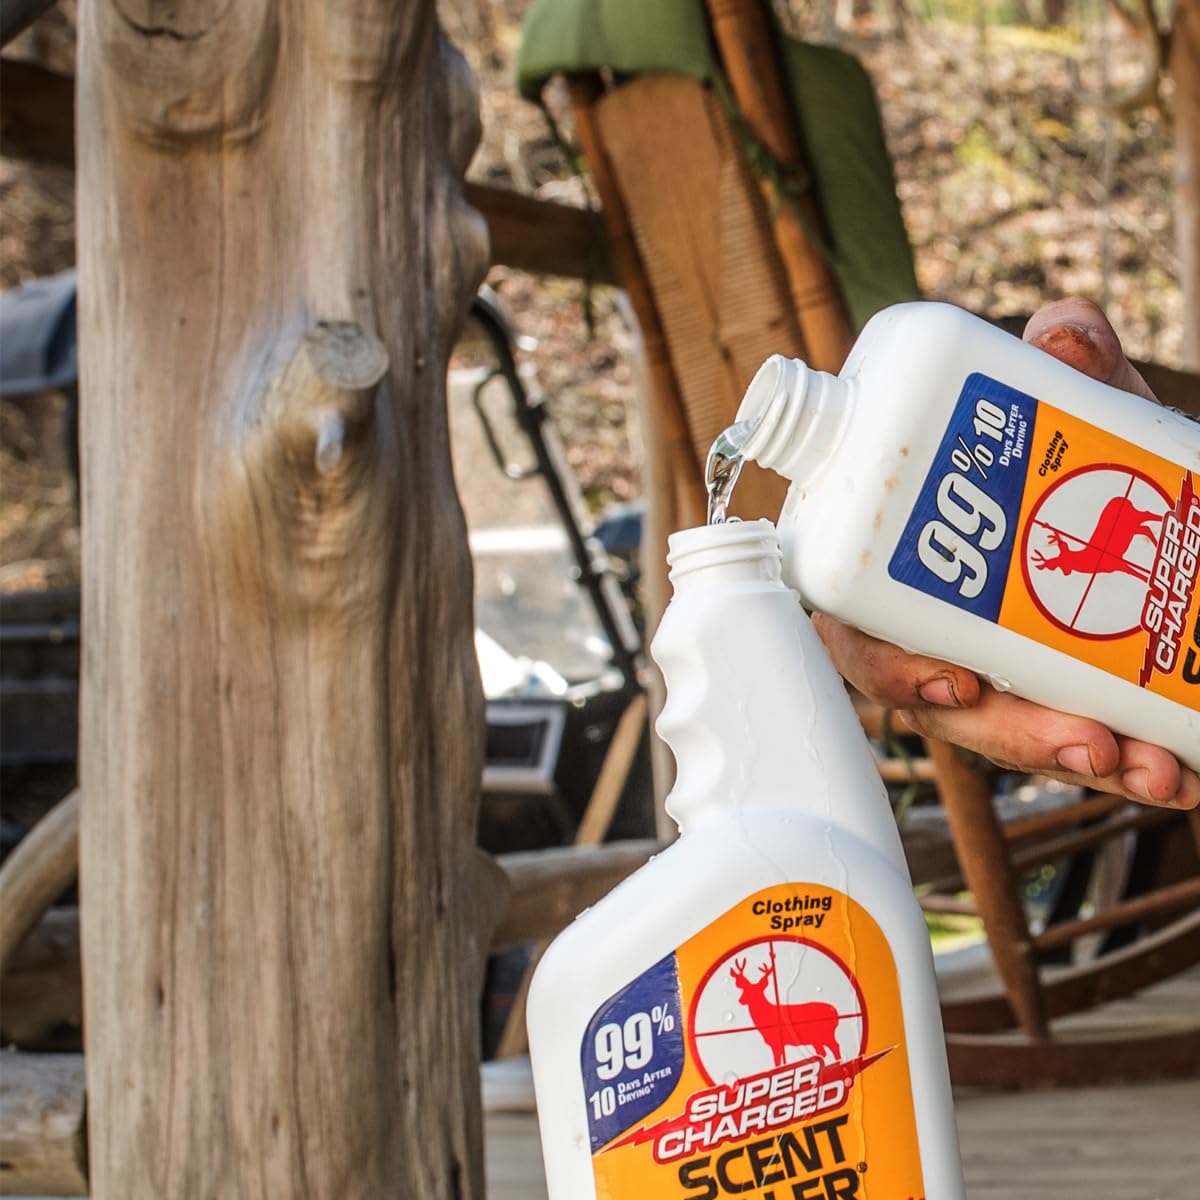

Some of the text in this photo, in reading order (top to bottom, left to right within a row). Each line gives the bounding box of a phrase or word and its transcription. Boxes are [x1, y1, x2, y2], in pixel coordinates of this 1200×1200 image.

[1038, 429, 1064, 477] Clothing
[1050, 439, 1069, 472] Spray
[917, 434, 1008, 600] 99%
[1145, 515, 1184, 633] SUPER
[751, 895, 832, 916] Clothing
[770, 913, 826, 932] Spray
[594, 1002, 675, 1081] 99%
[589, 1086, 616, 1121] 10
[689, 1061, 820, 1123] SUPER
